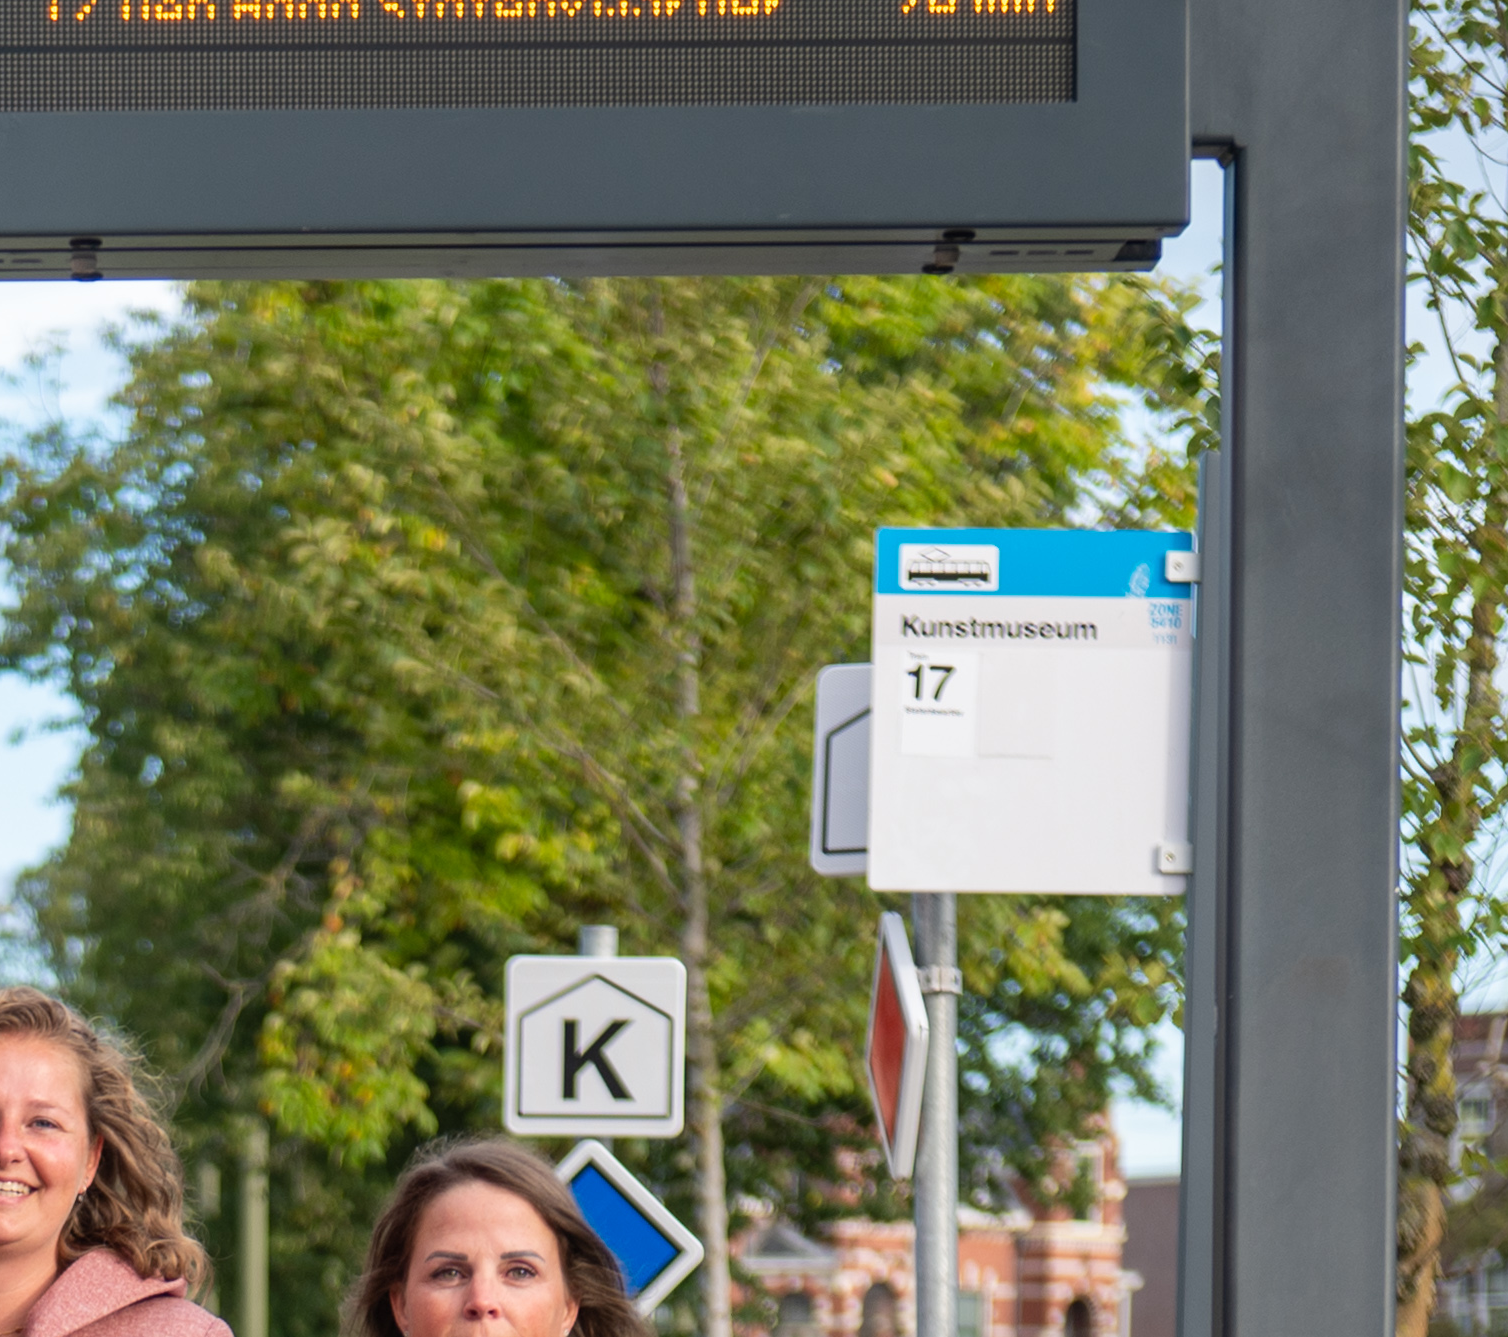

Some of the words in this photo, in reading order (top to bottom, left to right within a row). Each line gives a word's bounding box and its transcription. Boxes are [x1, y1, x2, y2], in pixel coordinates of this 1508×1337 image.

[900, 613, 1098, 640] Kunstmuseum
[906, 663, 957, 701] 17
[561, 1018, 635, 1100] K
